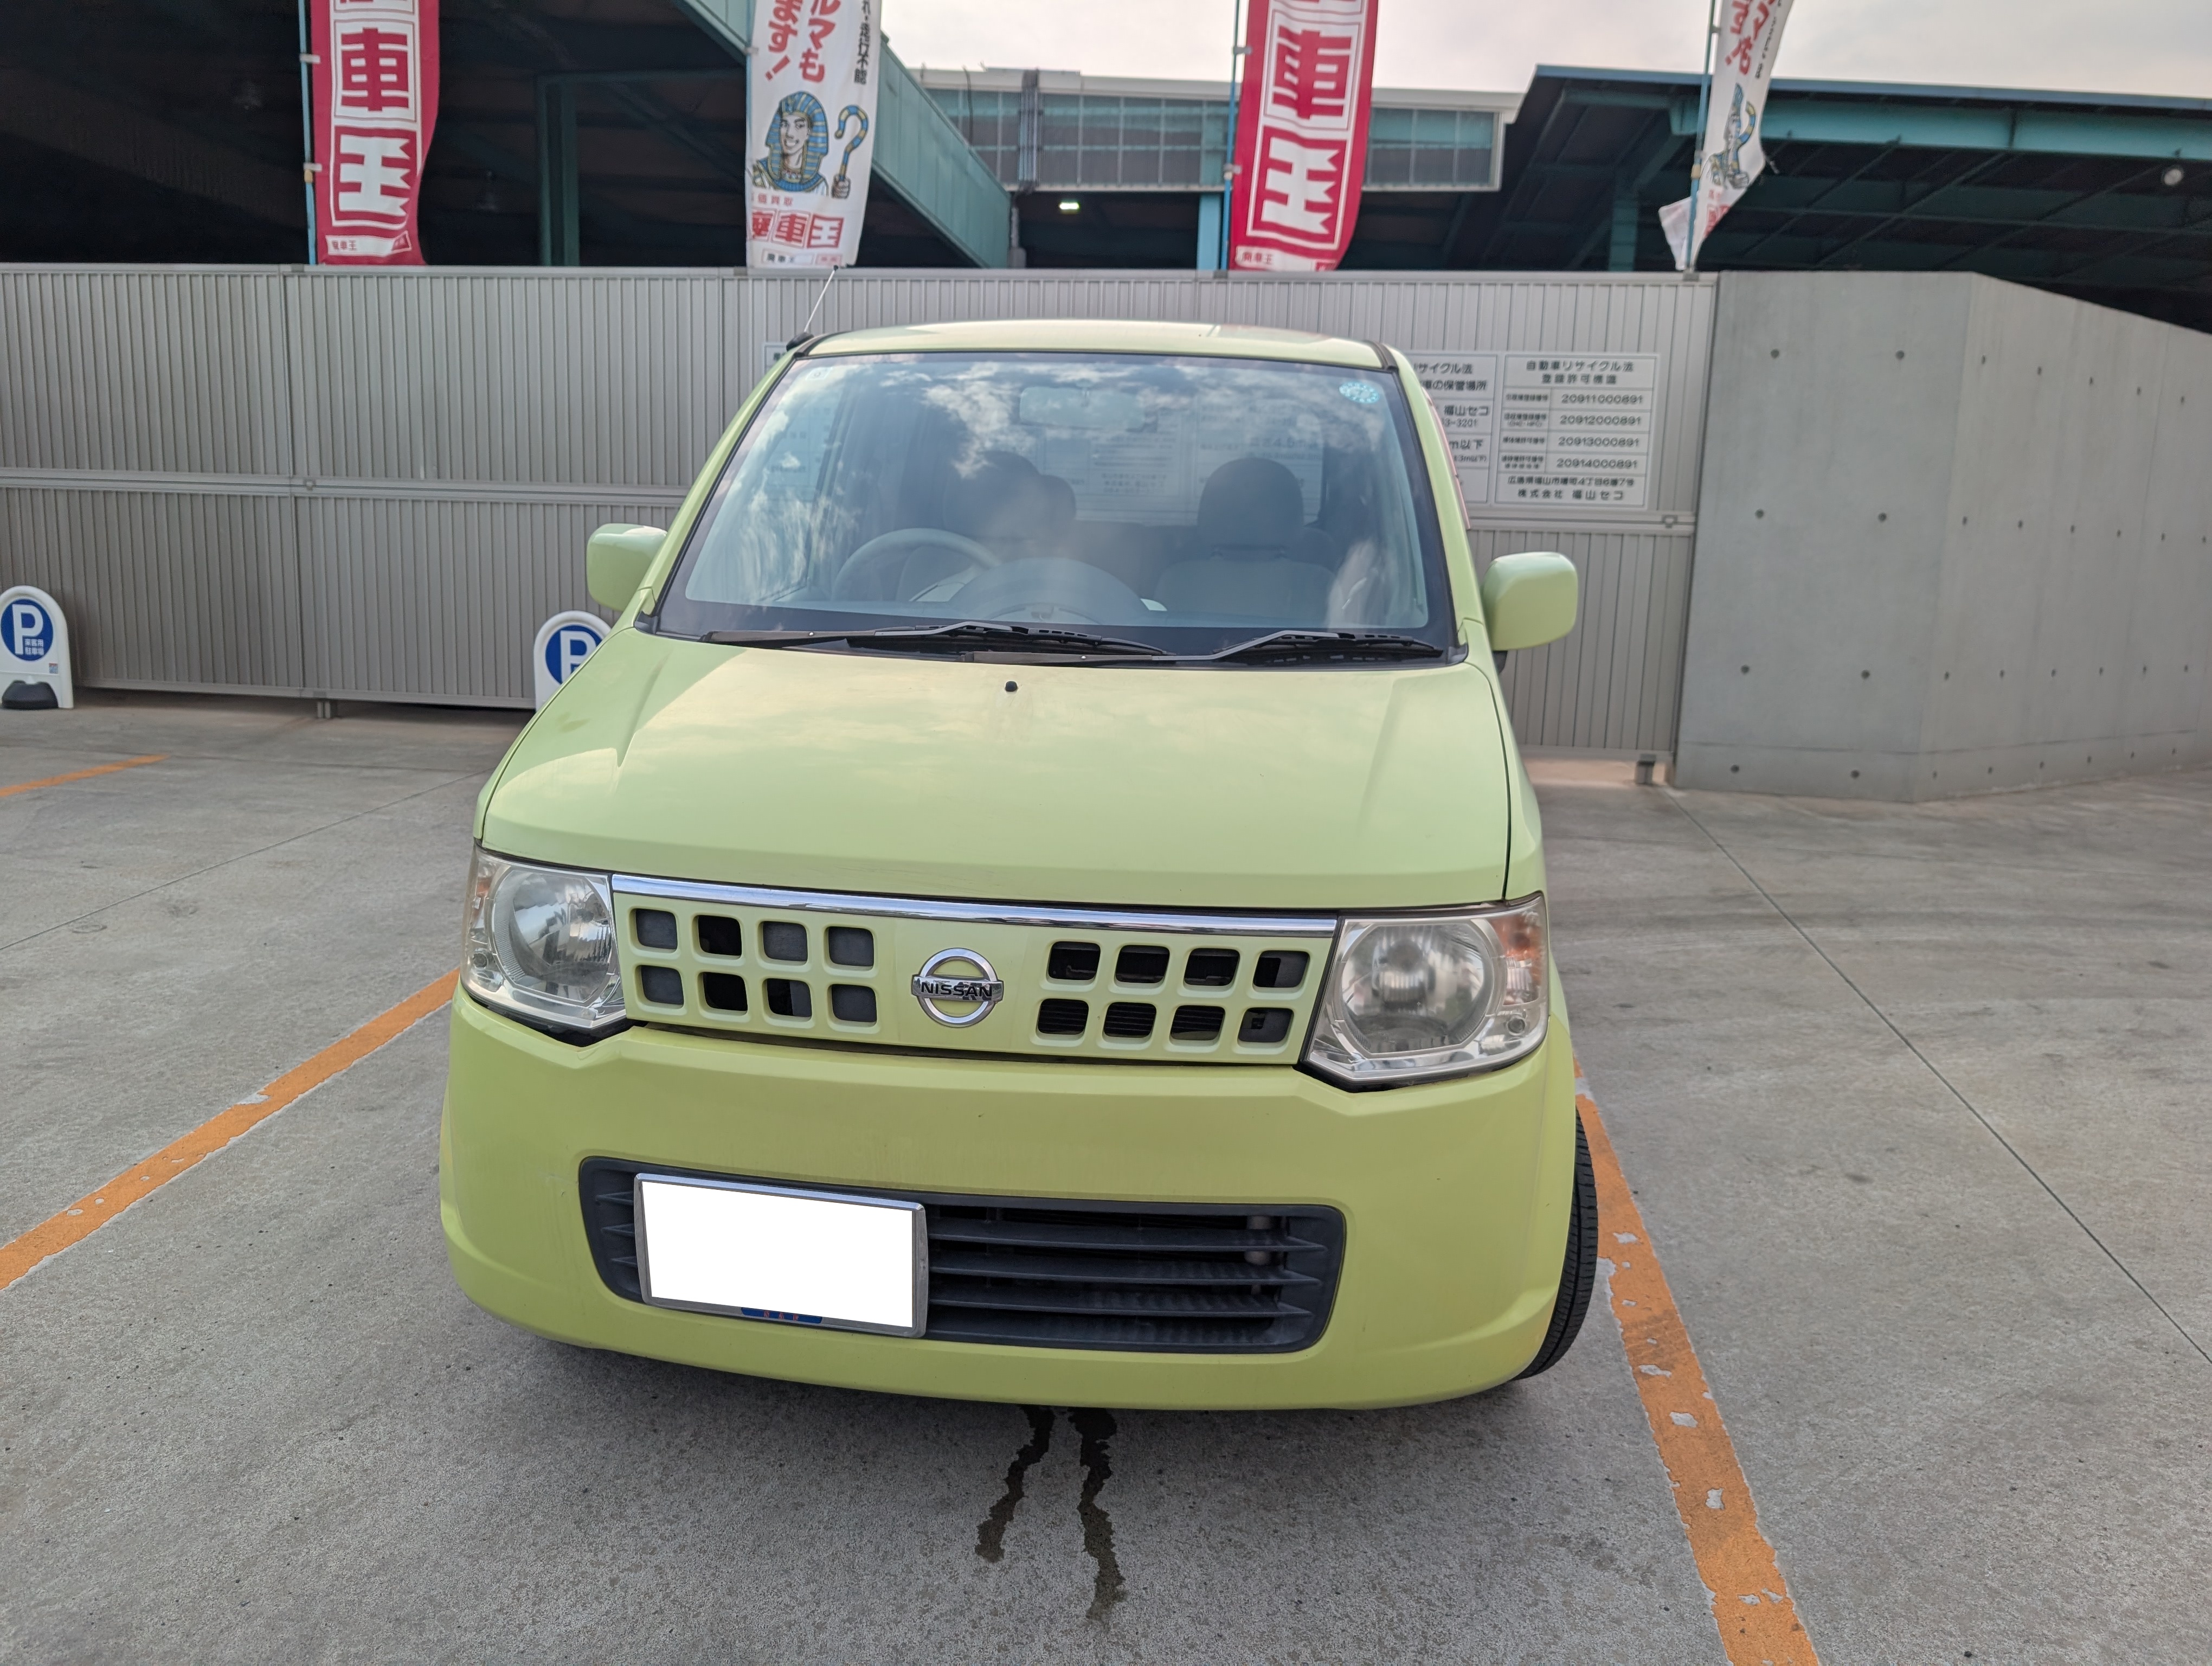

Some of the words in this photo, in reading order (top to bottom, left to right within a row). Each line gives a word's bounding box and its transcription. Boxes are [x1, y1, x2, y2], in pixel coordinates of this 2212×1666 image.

[339, 0, 412, 217] 車王
[1261, 0, 1352, 235] 車王
[1526, 360, 1634, 373] 自動車リサイクル法
[1561, 394, 1643, 405] 20911000891
[1444, 405, 1489, 416] 福山セコ
[1560, 415, 1641, 426] 20912000891
[1558, 437, 1639, 447] 20913000891
[1557, 458, 1637, 469] 20914000891
[1572, 490, 1624, 501] 福山セコ
[12, 604, 43, 655] P
[921, 982, 992, 997] NISSAN
